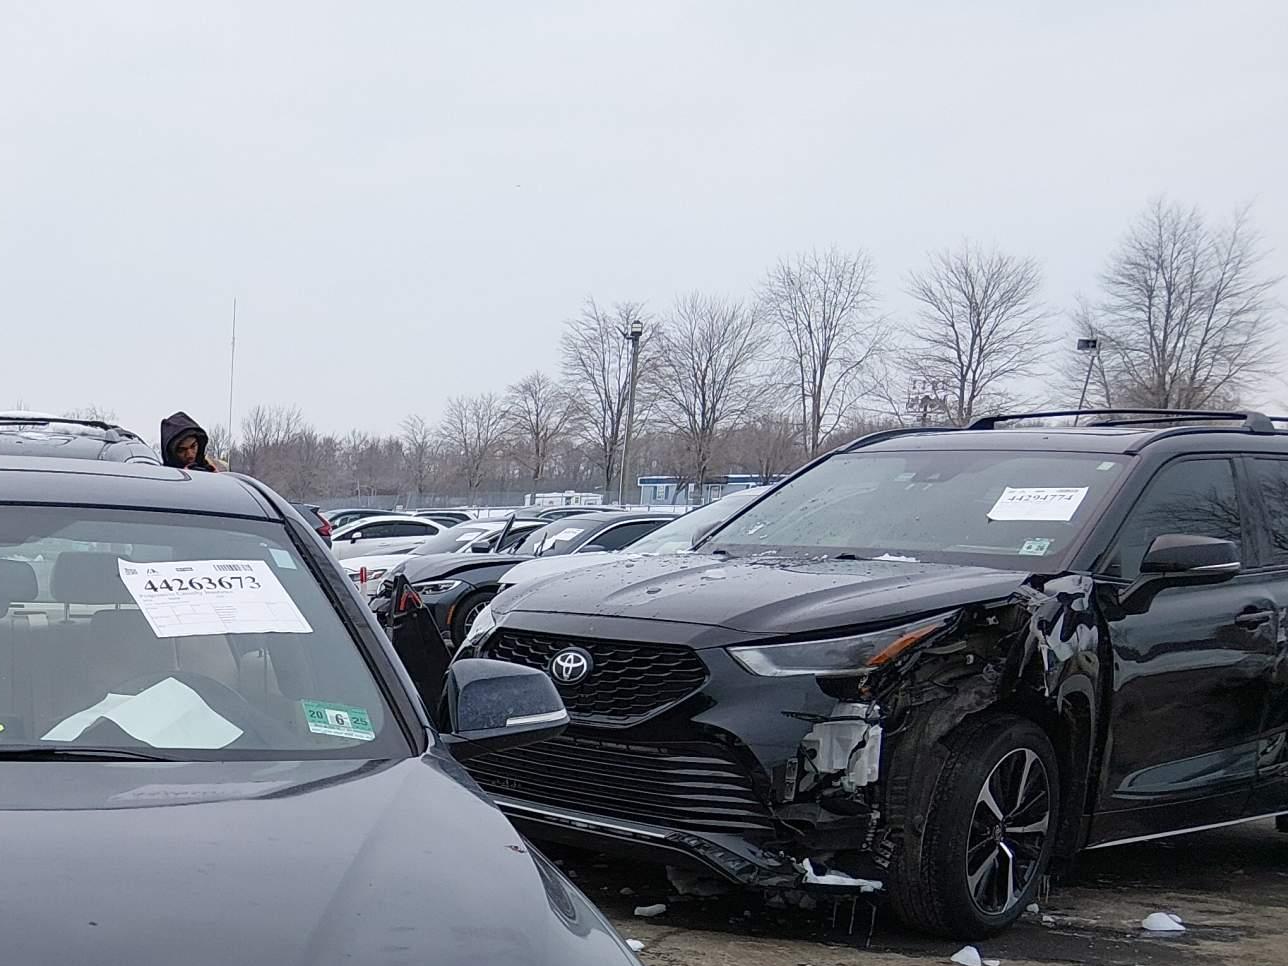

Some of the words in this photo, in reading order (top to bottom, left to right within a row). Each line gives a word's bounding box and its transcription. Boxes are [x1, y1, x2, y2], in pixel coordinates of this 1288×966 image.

[144, 576, 262, 592] 44263673
[308, 709, 323, 719] 20
[335, 713, 345, 725] 6
[351, 716, 368, 726] 25
